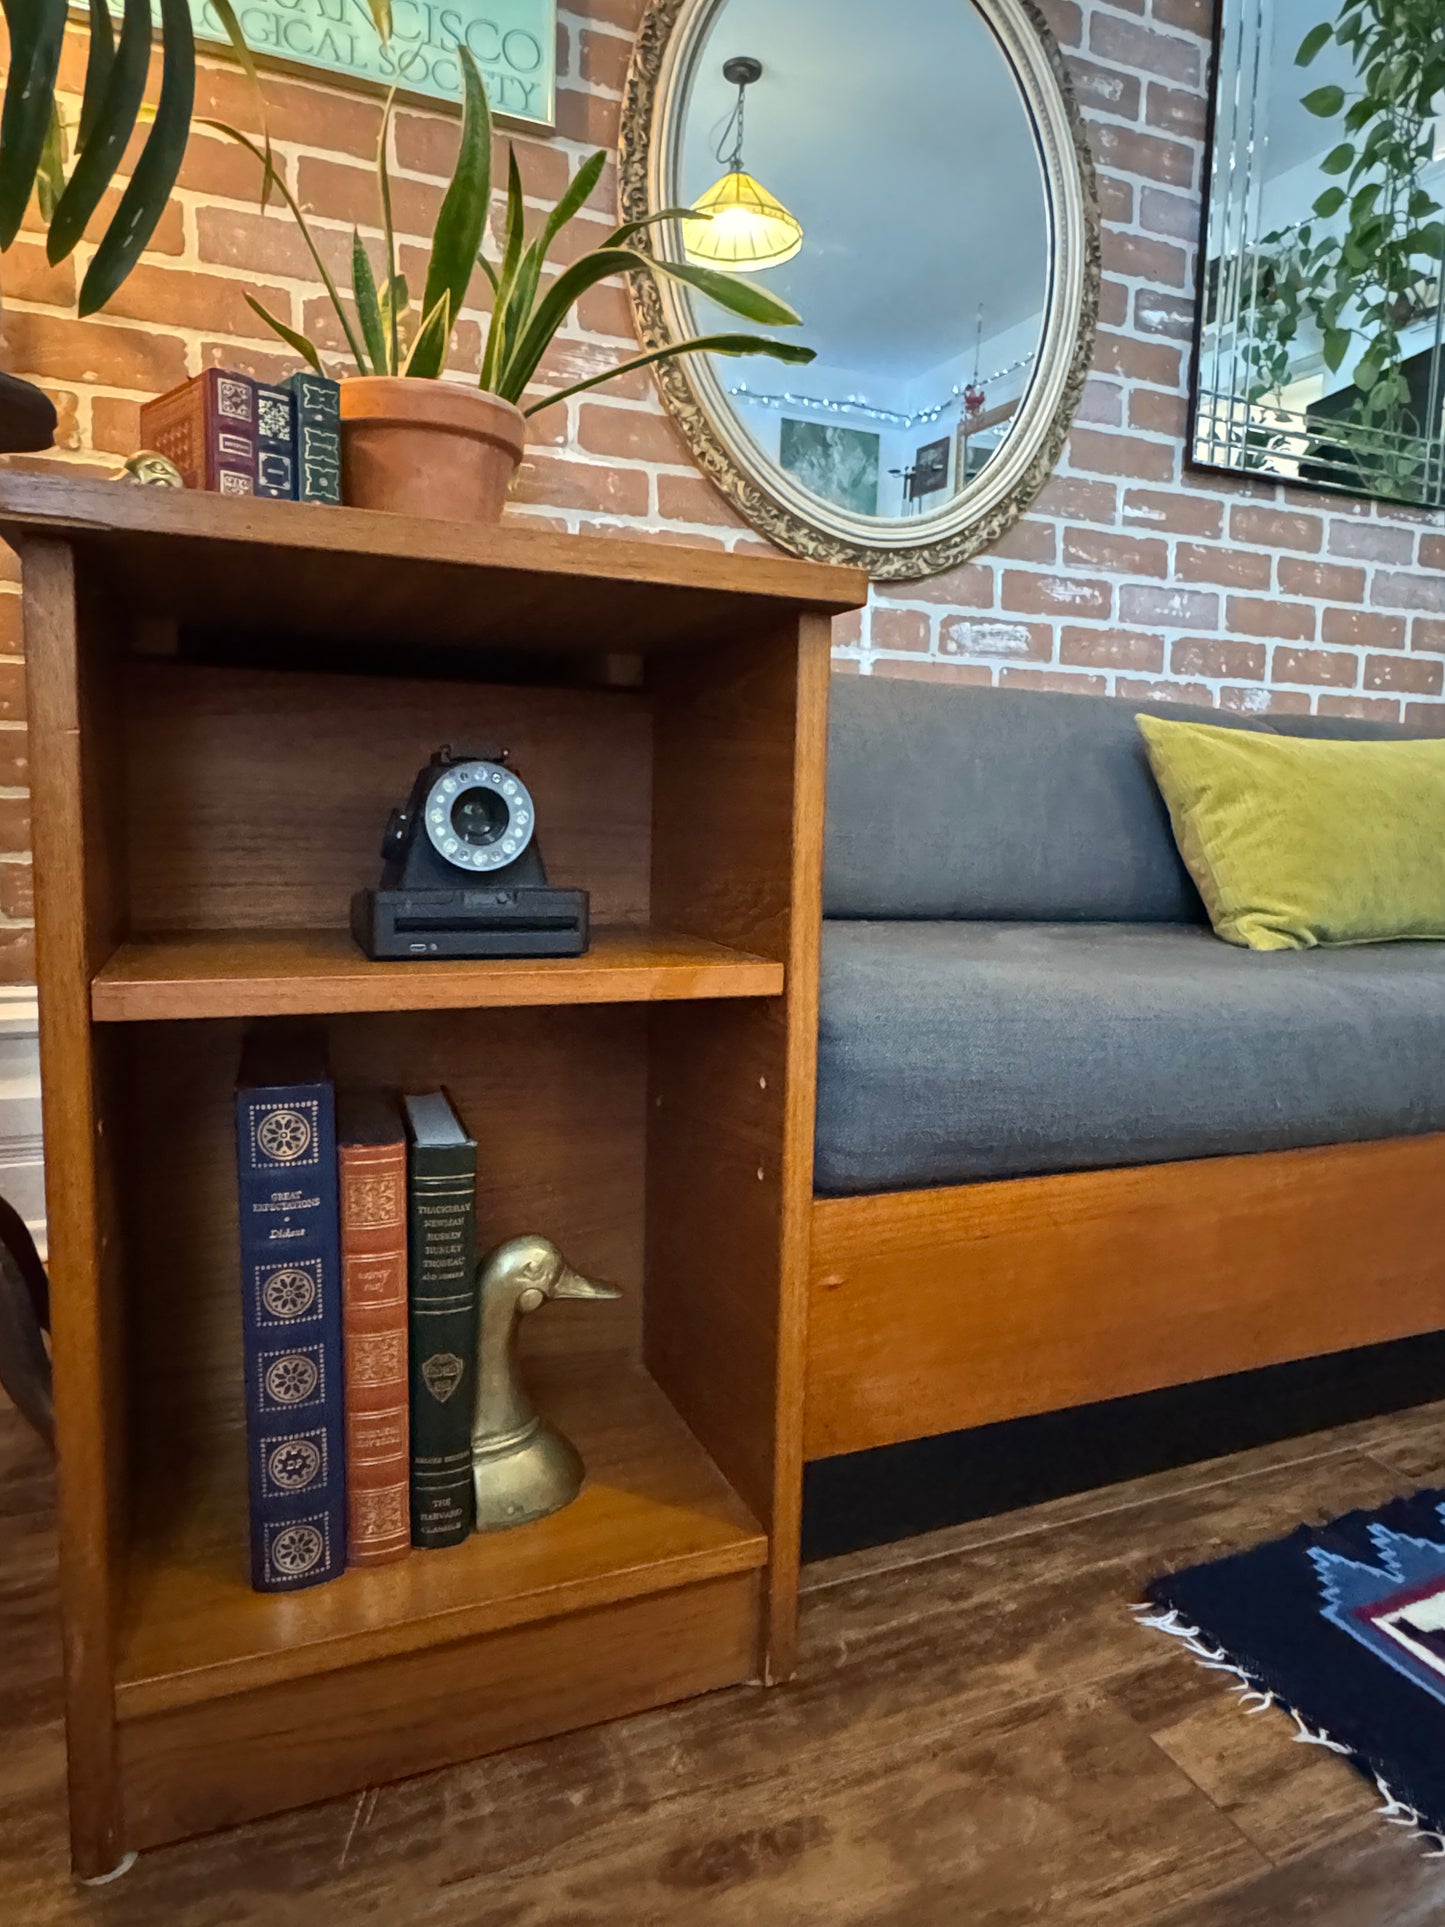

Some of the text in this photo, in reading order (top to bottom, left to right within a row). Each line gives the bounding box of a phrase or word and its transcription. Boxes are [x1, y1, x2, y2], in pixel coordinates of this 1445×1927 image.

[260, 0, 543, 74] CISCO
[198, 0, 541, 111] OGICAL SOCTY
[270, 1190, 302, 1201] GREAT
[416, 1202, 471, 1214] THACKERAY
[431, 1497, 452, 1508] THE
[420, 1508, 463, 1520] HARVARD
